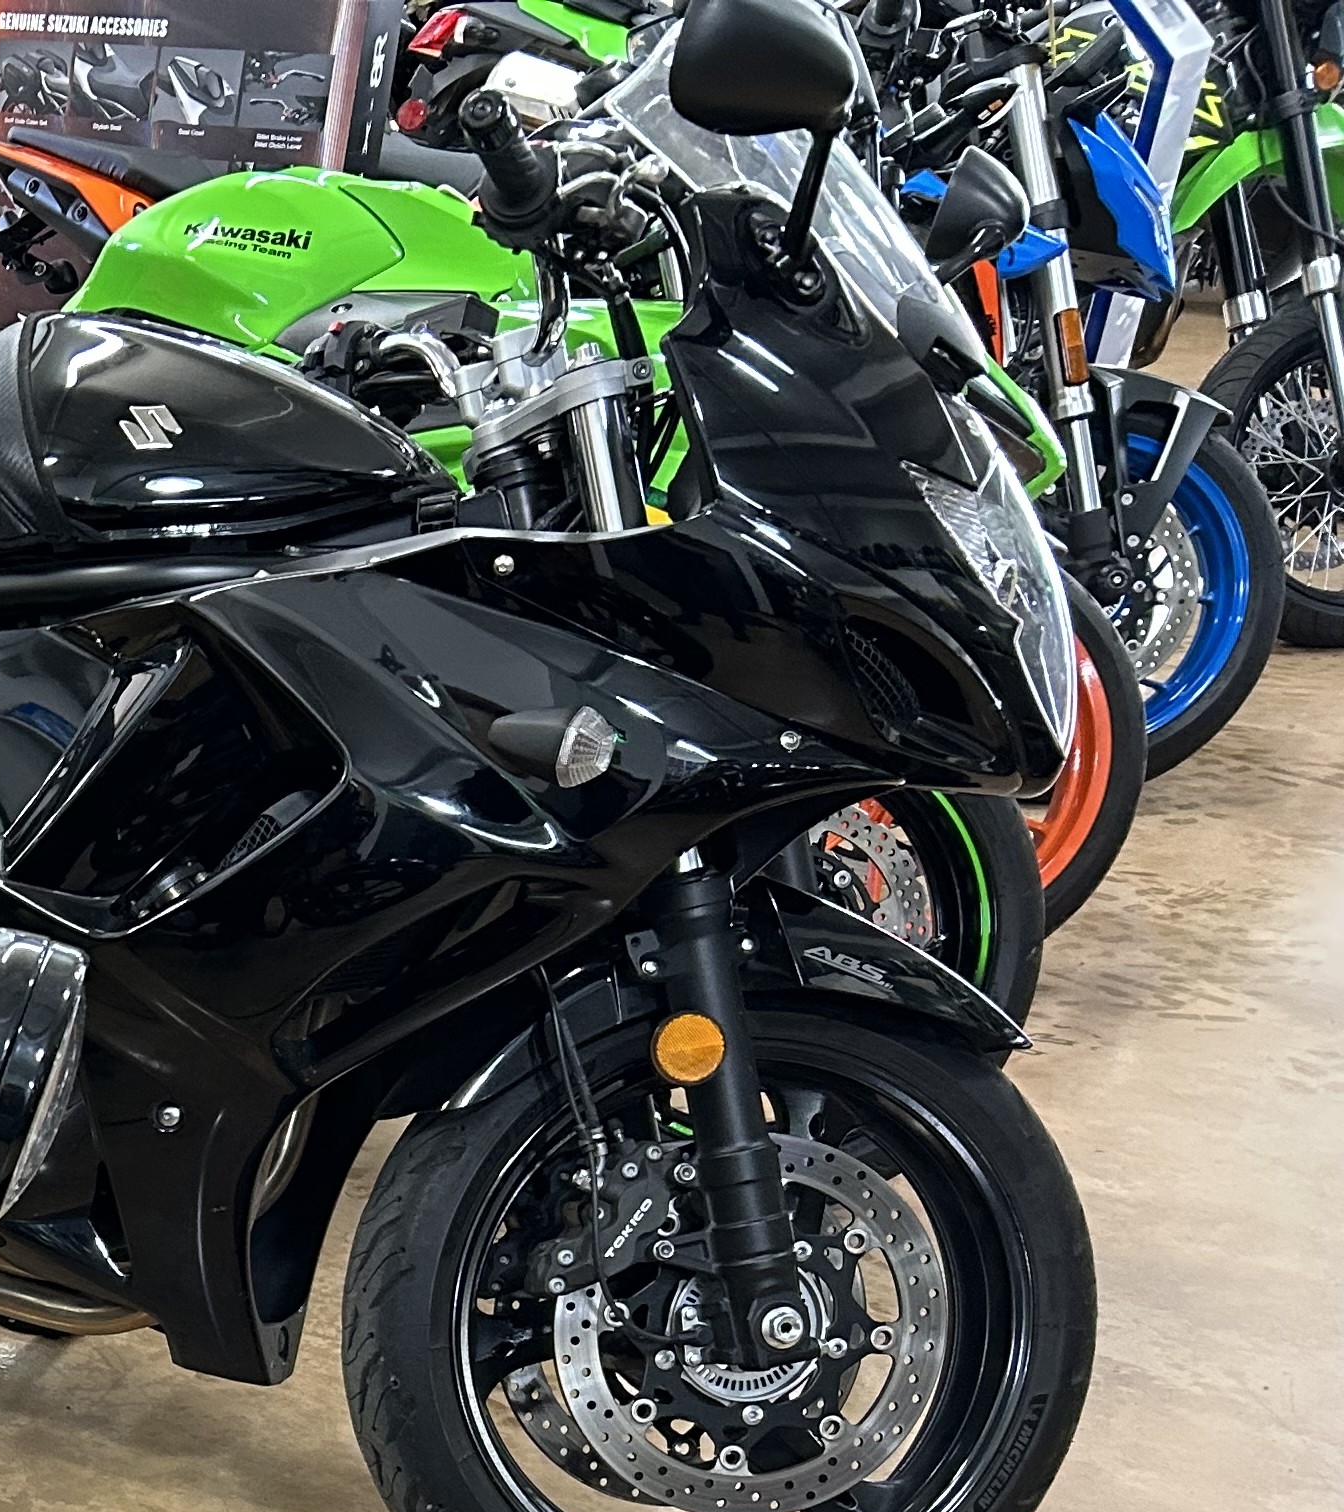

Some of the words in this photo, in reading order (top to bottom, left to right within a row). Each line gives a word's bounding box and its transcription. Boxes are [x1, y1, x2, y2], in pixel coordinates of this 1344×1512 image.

[47, 14, 89, 33] SUZUKI
[90, 16, 169, 38] ACCESSORIES
[251, 243, 292, 260] Team
[803, 945, 888, 983] ABS
[604, 1198, 653, 1258] TOKICO
[976, 1419, 1033, 1508] MICHELIN
